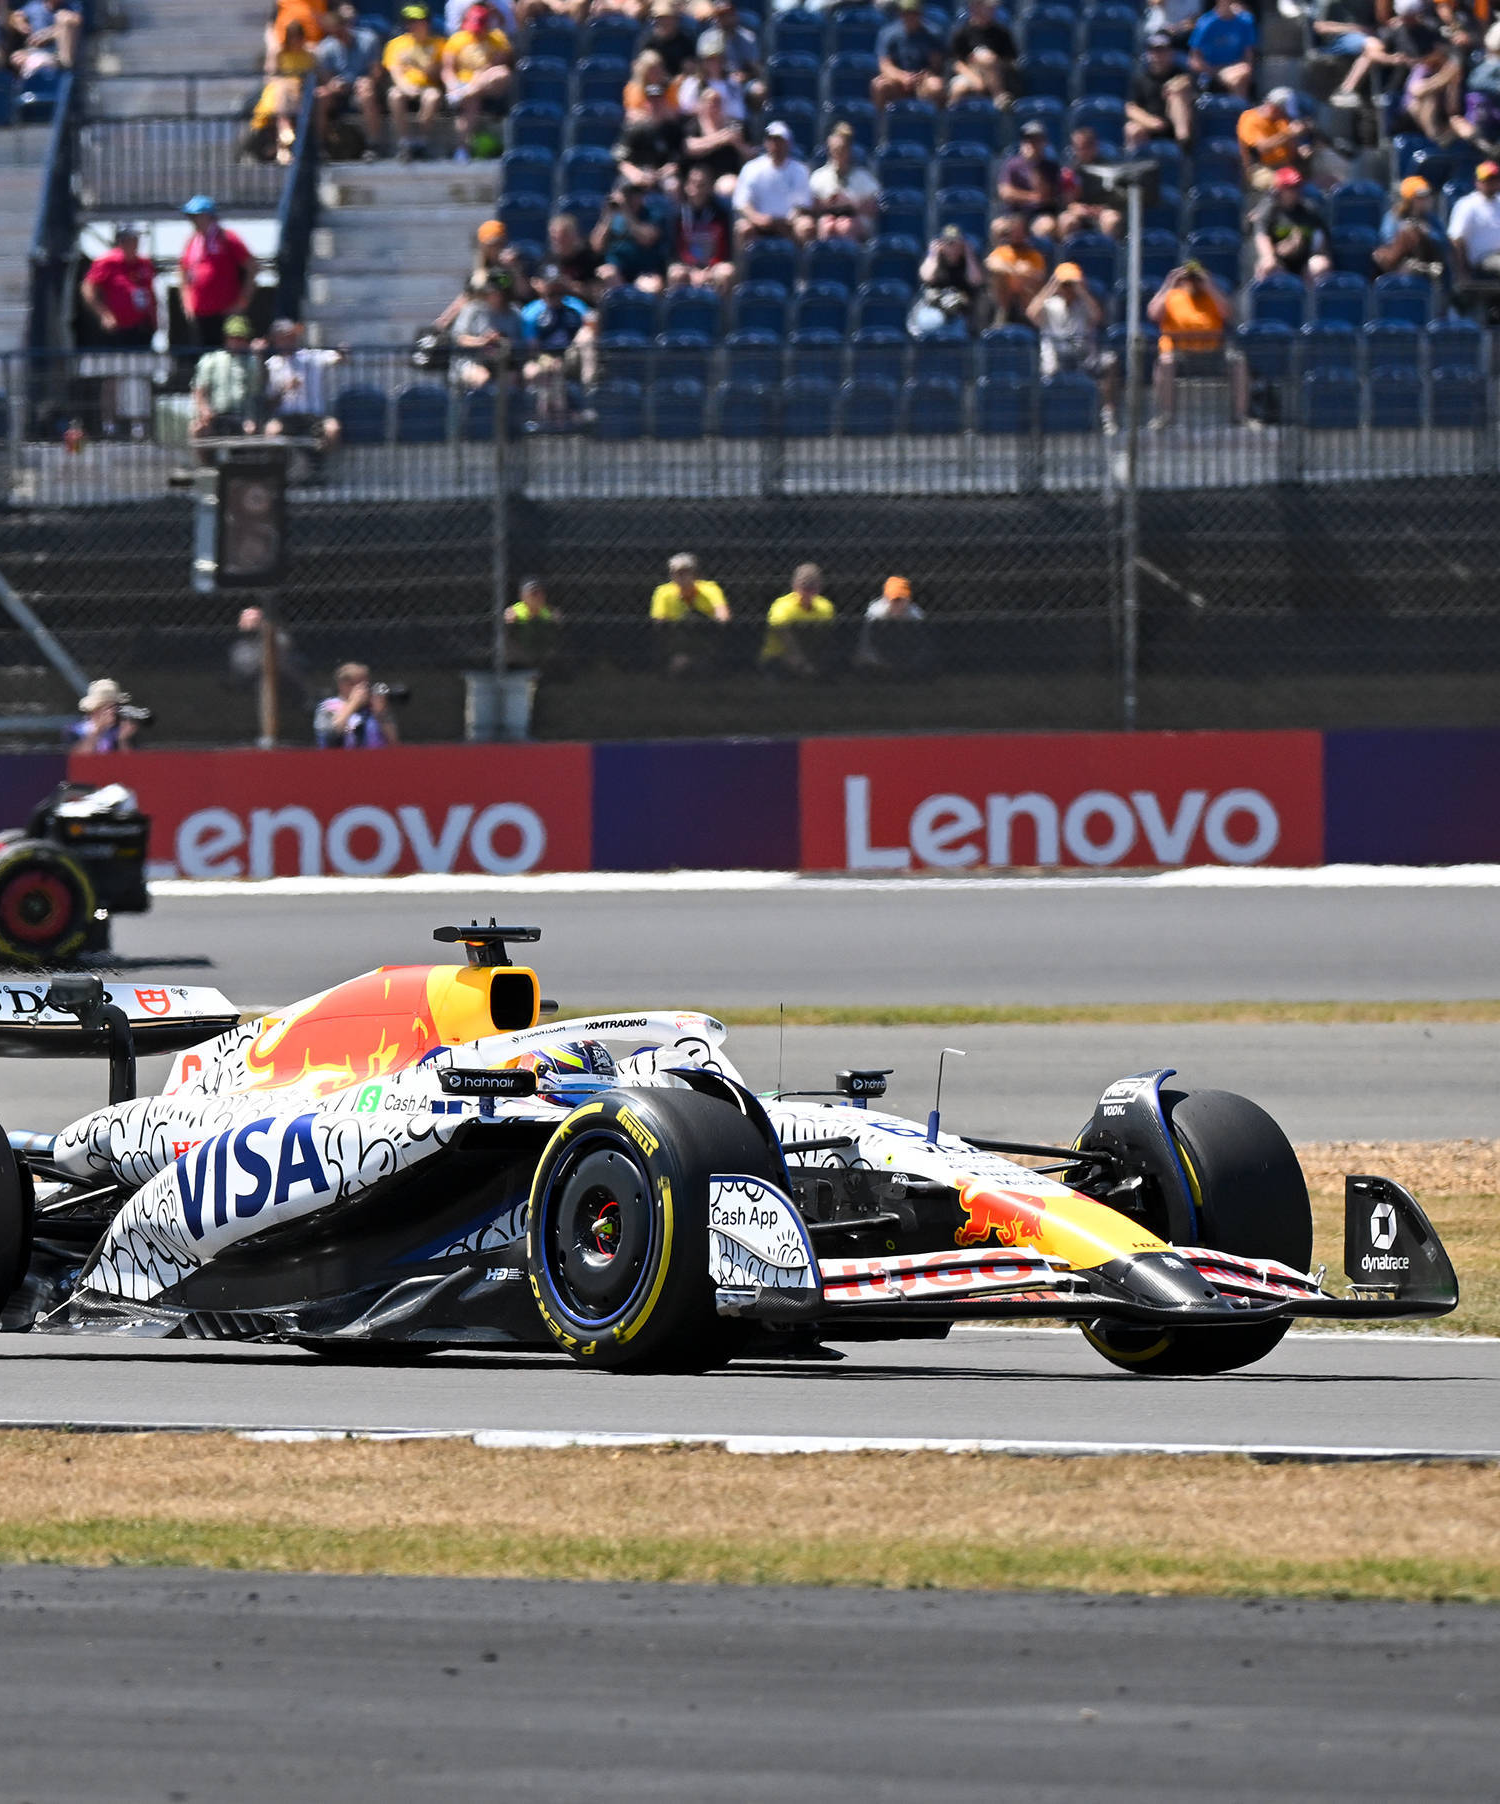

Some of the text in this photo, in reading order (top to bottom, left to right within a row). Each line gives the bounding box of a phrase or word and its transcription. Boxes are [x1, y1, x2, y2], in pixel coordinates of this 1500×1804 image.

[146, 802, 547, 879] enovo
[845, 775, 1281, 870] Lenovo
[464, 1076, 515, 1088] hahnair
[384, 1094, 416, 1112] Cash
[615, 1104, 660, 1158] PIRELLI
[176, 1112, 331, 1241] VISA
[712, 1206, 778, 1229] Cash App
[1361, 1253, 1410, 1273] dynatrace
